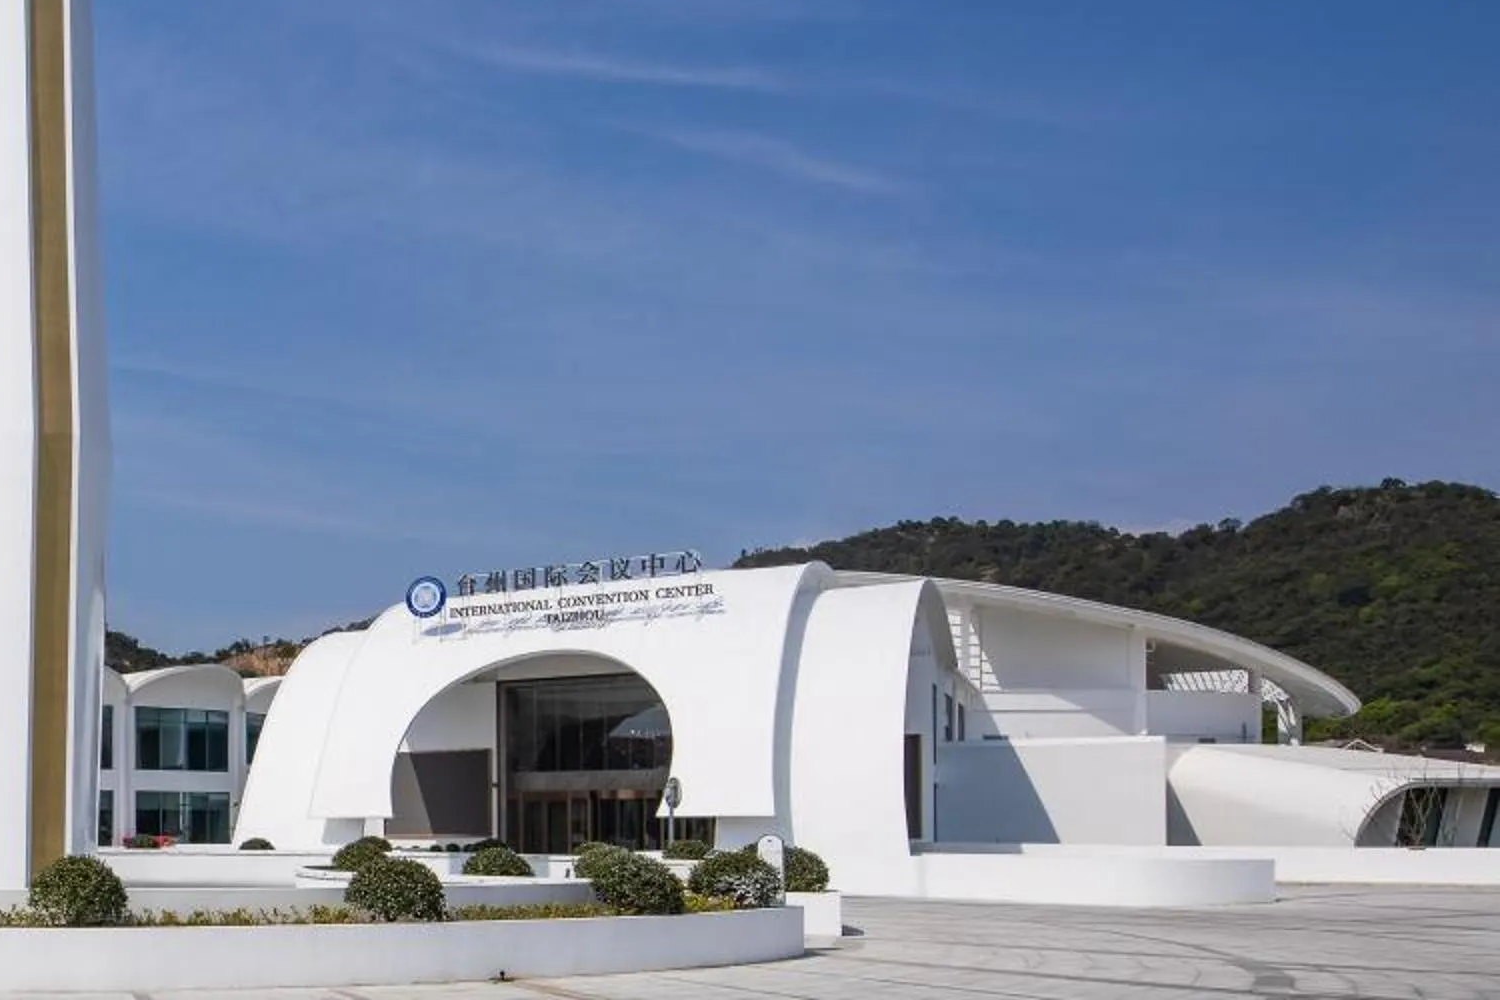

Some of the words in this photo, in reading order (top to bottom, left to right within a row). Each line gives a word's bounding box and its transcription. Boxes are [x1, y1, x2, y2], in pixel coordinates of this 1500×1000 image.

[457, 551, 701, 596] 台州国际会议中心
[450, 600, 552, 618] INTERNATIONAL
[557, 590, 649, 608] CONVENTION
[655, 583, 714, 599] CENTER
[547, 610, 605, 624] TAIZHOU
